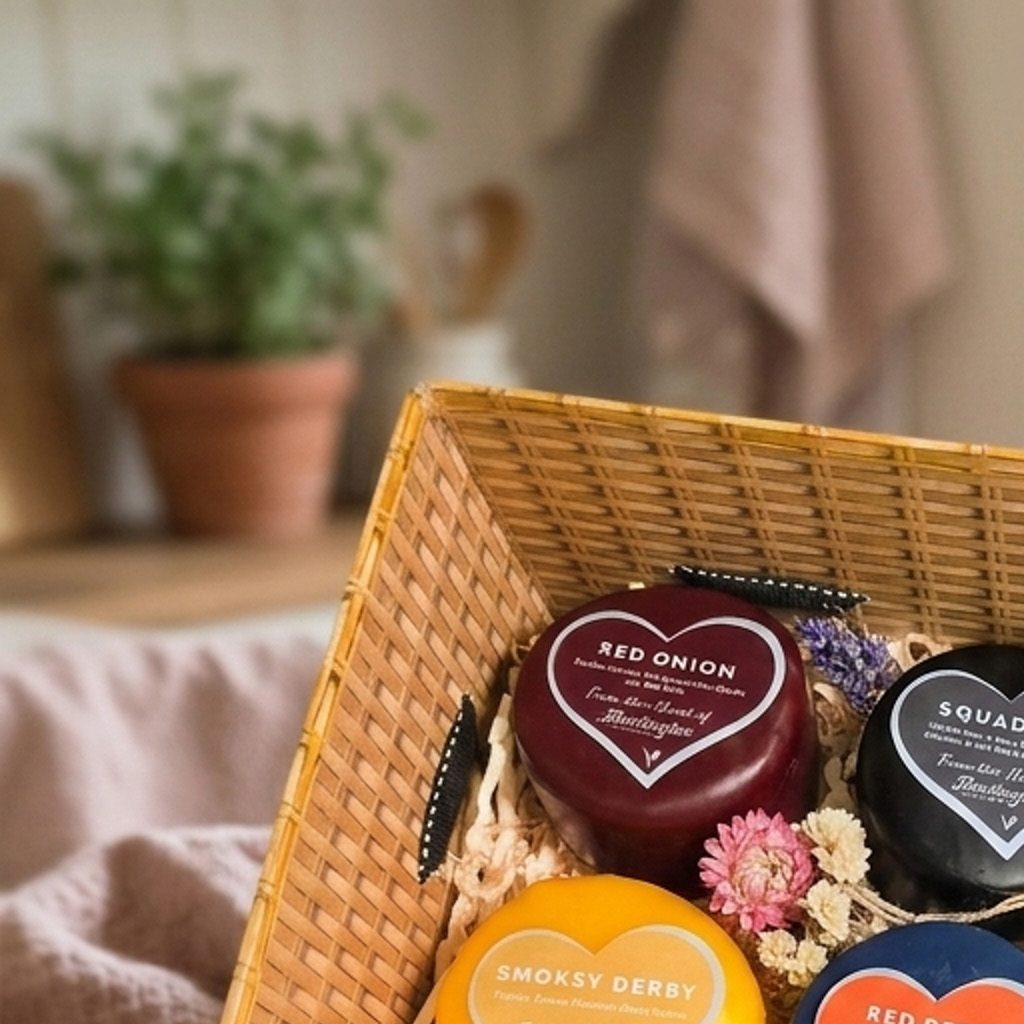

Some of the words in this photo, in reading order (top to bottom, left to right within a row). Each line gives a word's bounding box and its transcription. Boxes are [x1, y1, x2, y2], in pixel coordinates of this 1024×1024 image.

[597, 640, 645, 663] RED
[652, 651, 737, 680] ONION
[496, 965, 603, 989] SMOKSY
[612, 976, 697, 1001] DERBY
